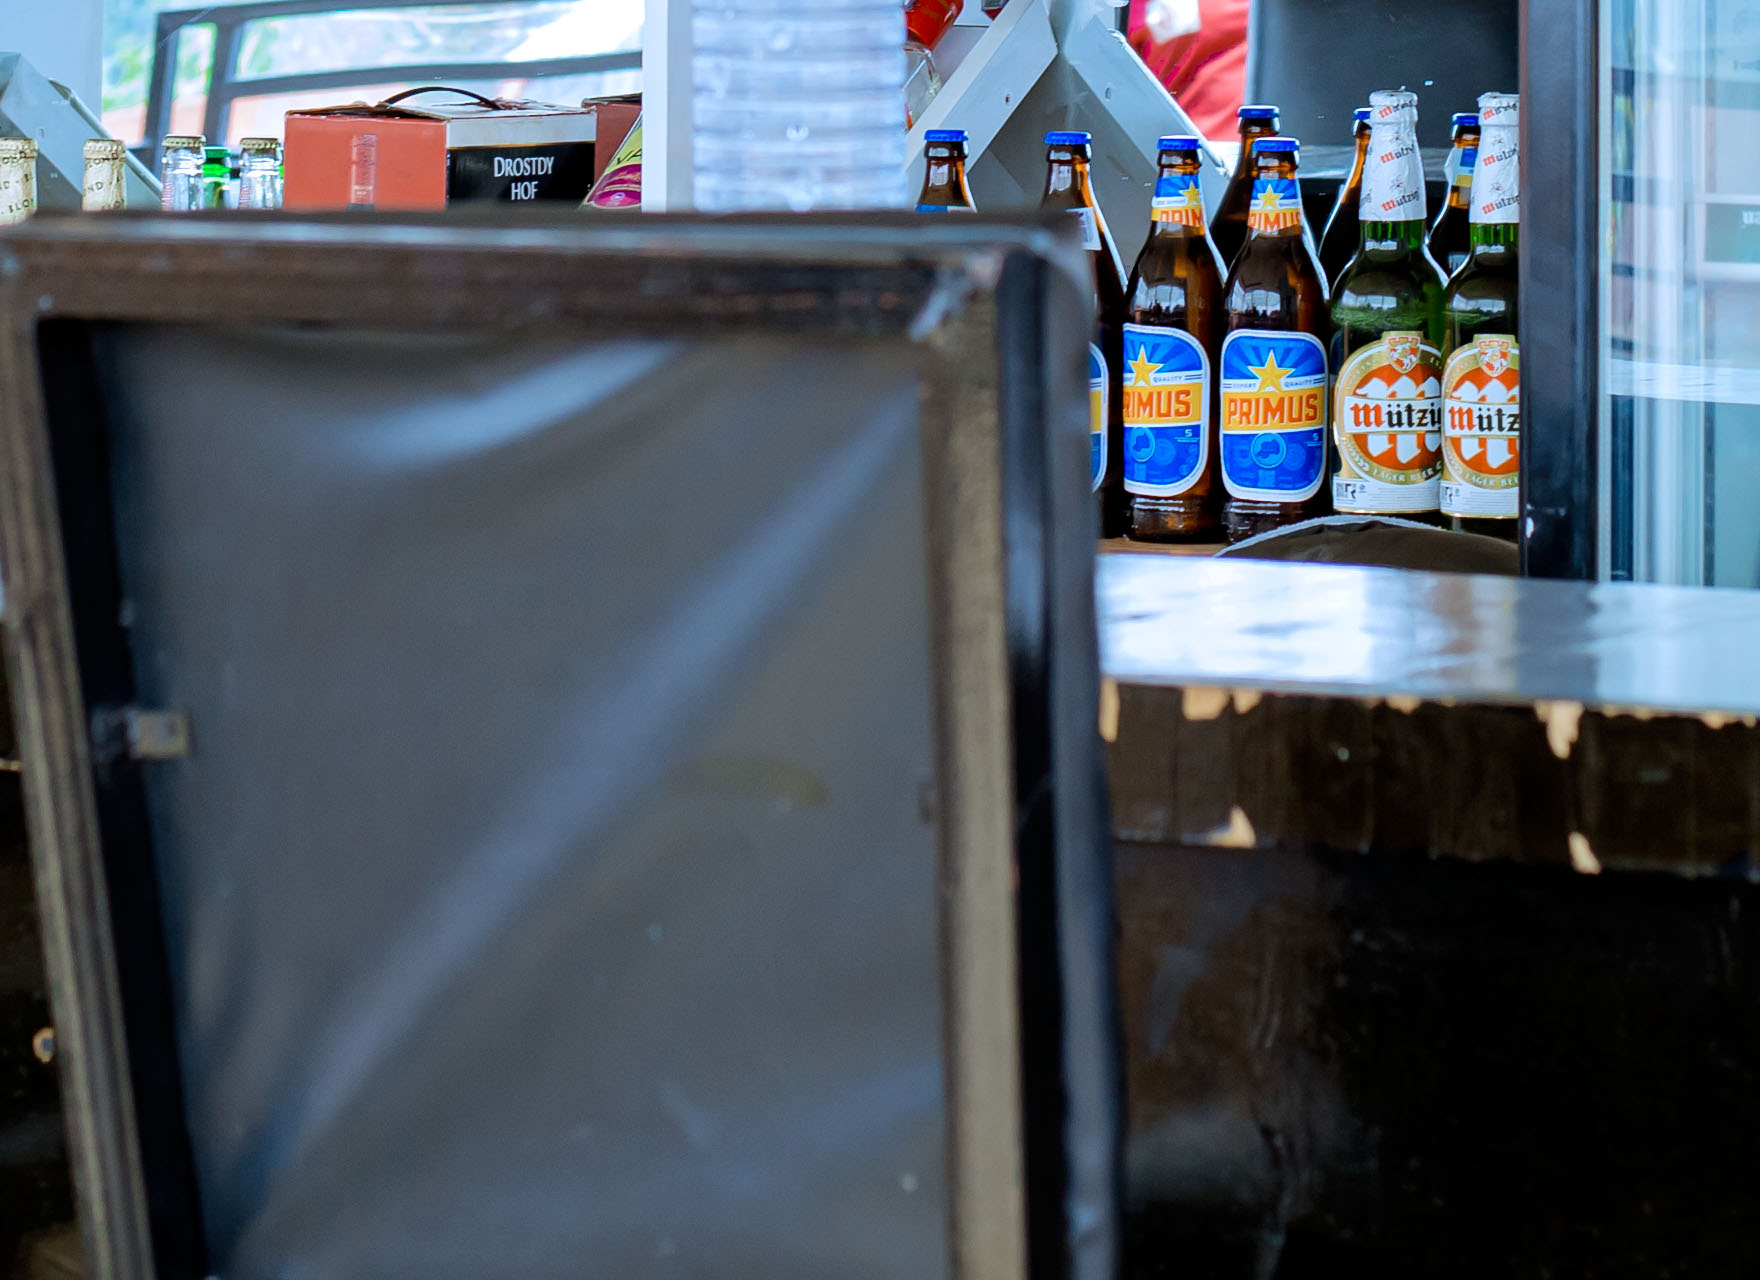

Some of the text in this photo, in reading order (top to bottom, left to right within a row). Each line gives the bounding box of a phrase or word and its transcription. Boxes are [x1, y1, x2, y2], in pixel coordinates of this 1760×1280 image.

[494, 156, 555, 177] DROSTDY
[616, 148, 642, 166] VA
[511, 181, 539, 200] HOF
[1228, 393, 1318, 425] PRIMUS
[1448, 406, 1521, 432] mütz
[1373, 468, 1406, 482] LAGER
